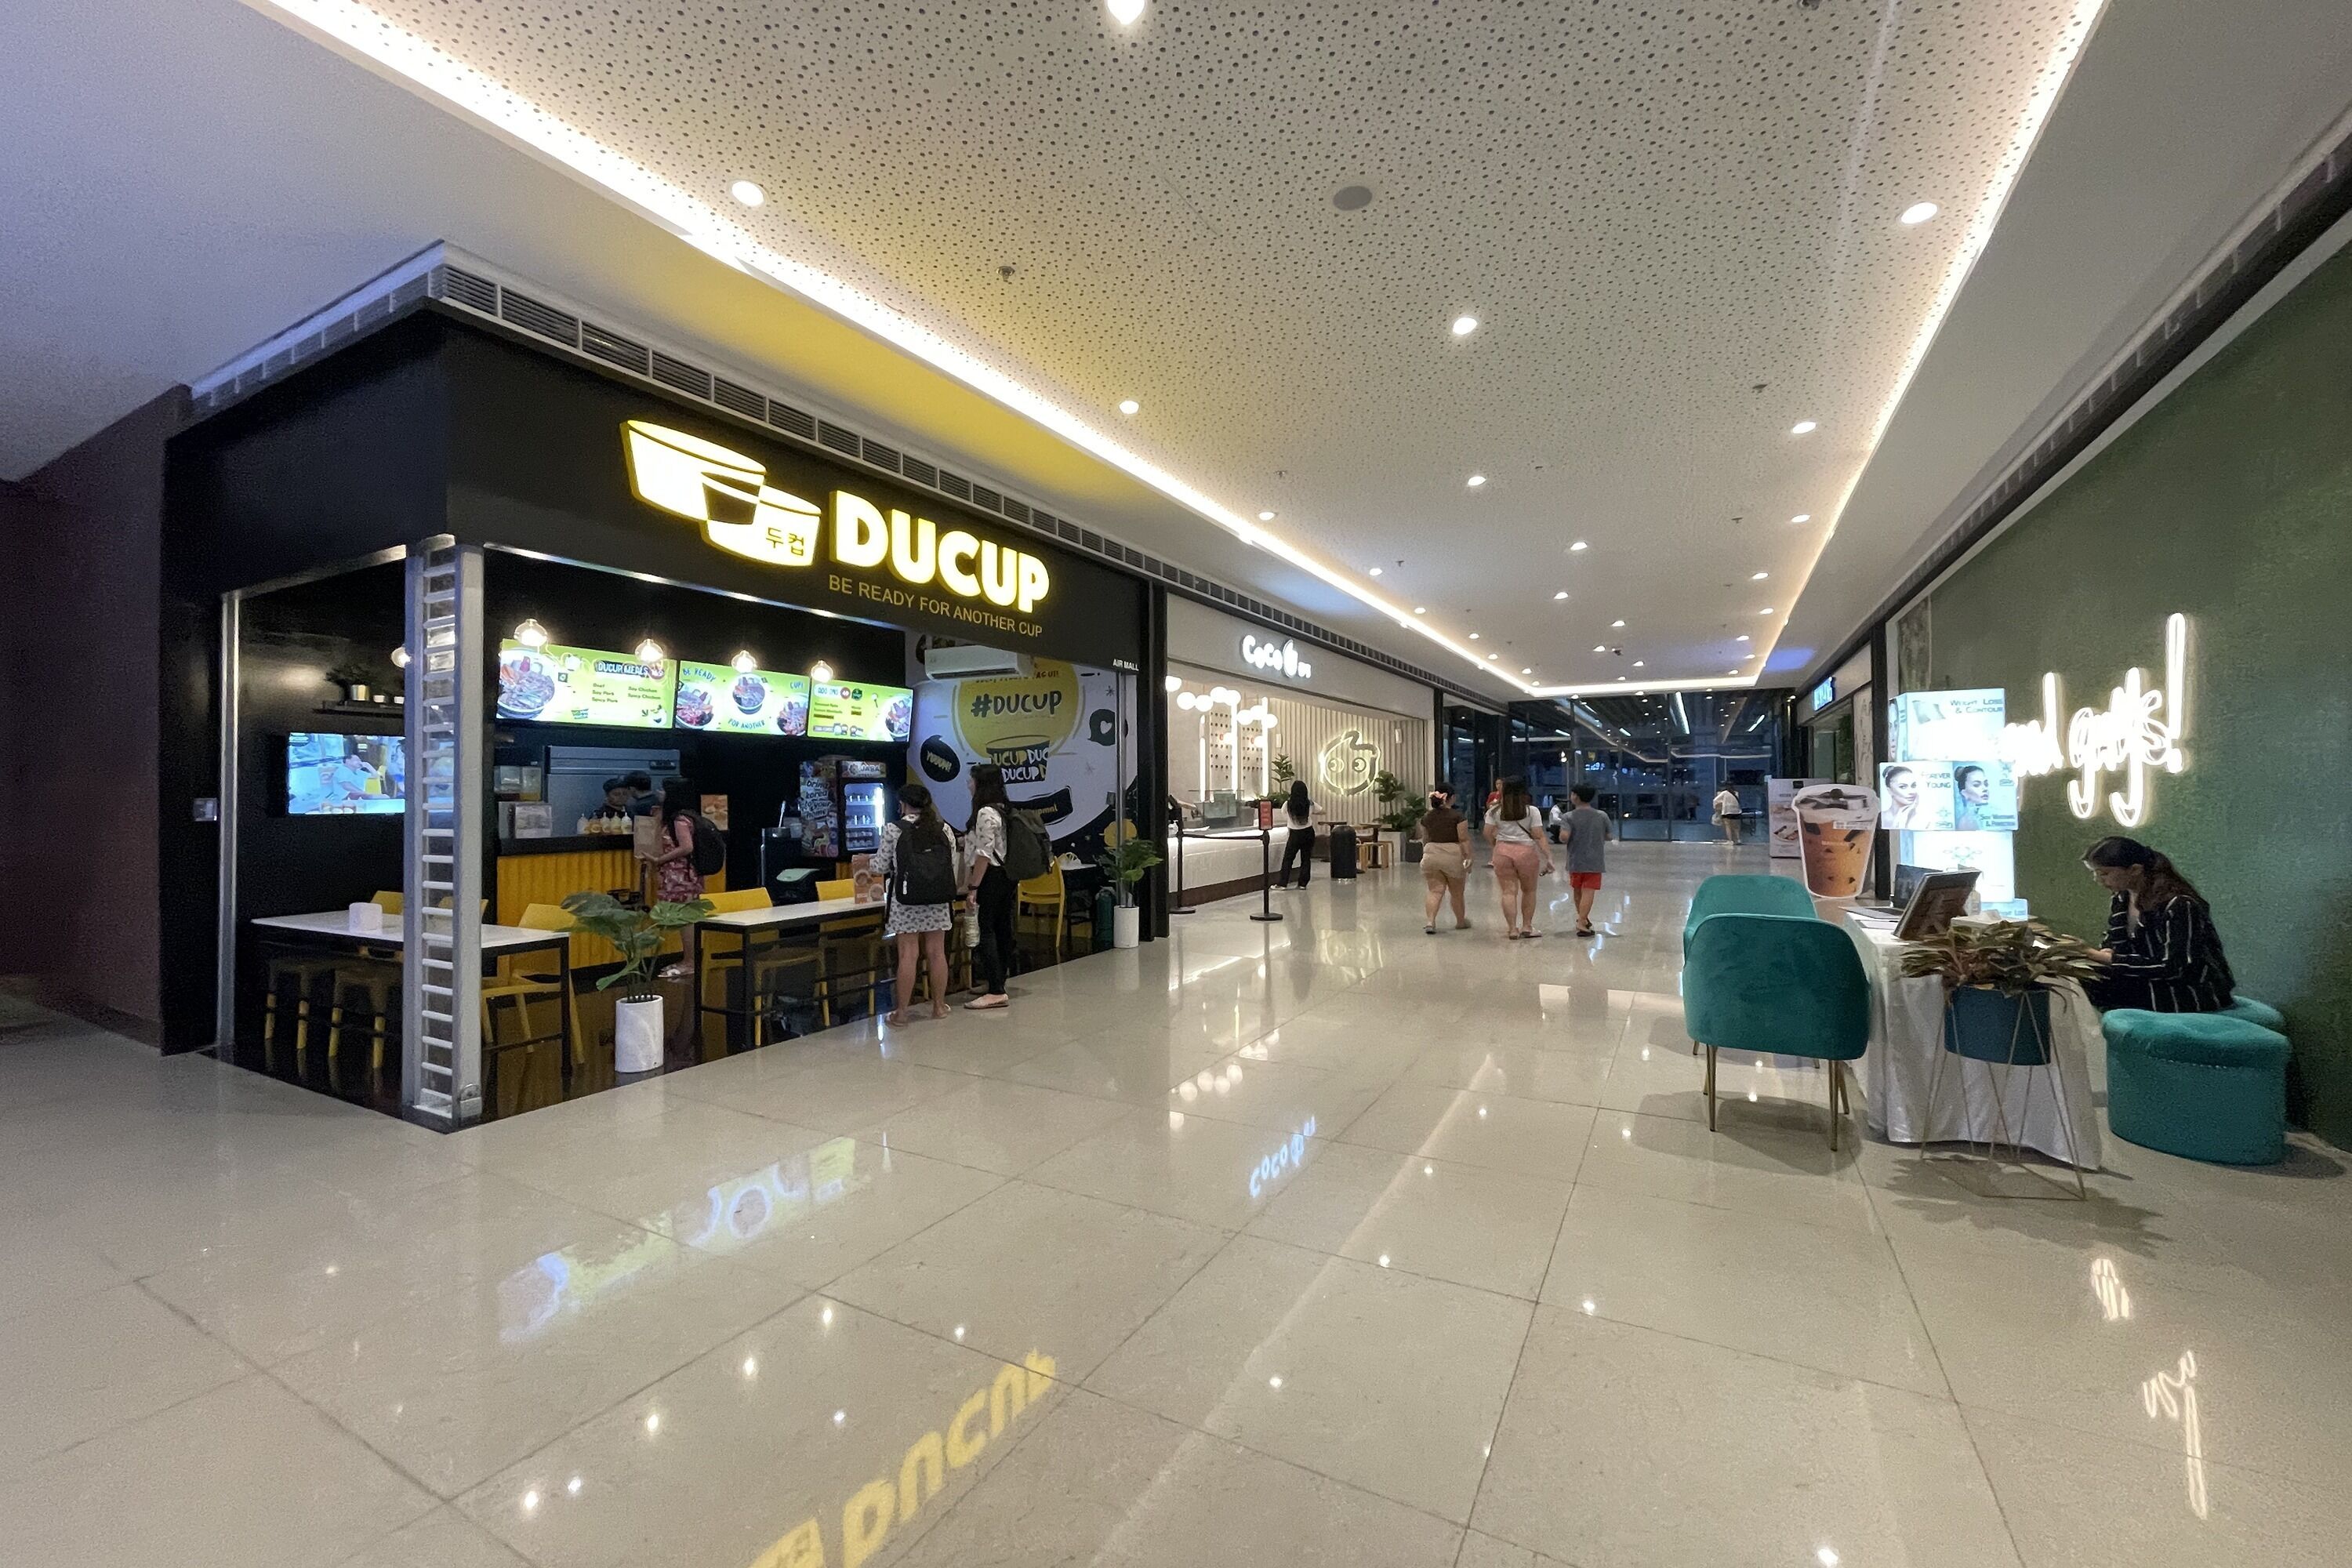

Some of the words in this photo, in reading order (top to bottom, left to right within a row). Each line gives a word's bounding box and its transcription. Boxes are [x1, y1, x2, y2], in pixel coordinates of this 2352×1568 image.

[766, 527, 804, 557] 두컵
[831, 489, 1050, 613] DUCUP
[829, 575, 853, 595] BE
[858, 582, 915, 608] READY
[920, 597, 949, 618] FOR
[953, 605, 1016, 632] ANOTHER
[1019, 622, 1043, 637] CUP
[598, 662, 623, 673] DUCUP
[1112, 659, 1123, 667] AIR
[1123, 661, 1139, 671] MALL
[695, 668, 717, 682] READY
[971, 691, 1062, 717] #DUCUP
[728, 718, 739, 728] FOR
[741, 720, 765, 730] ANOTHER
[1001, 765, 1040, 782] DUCUP
